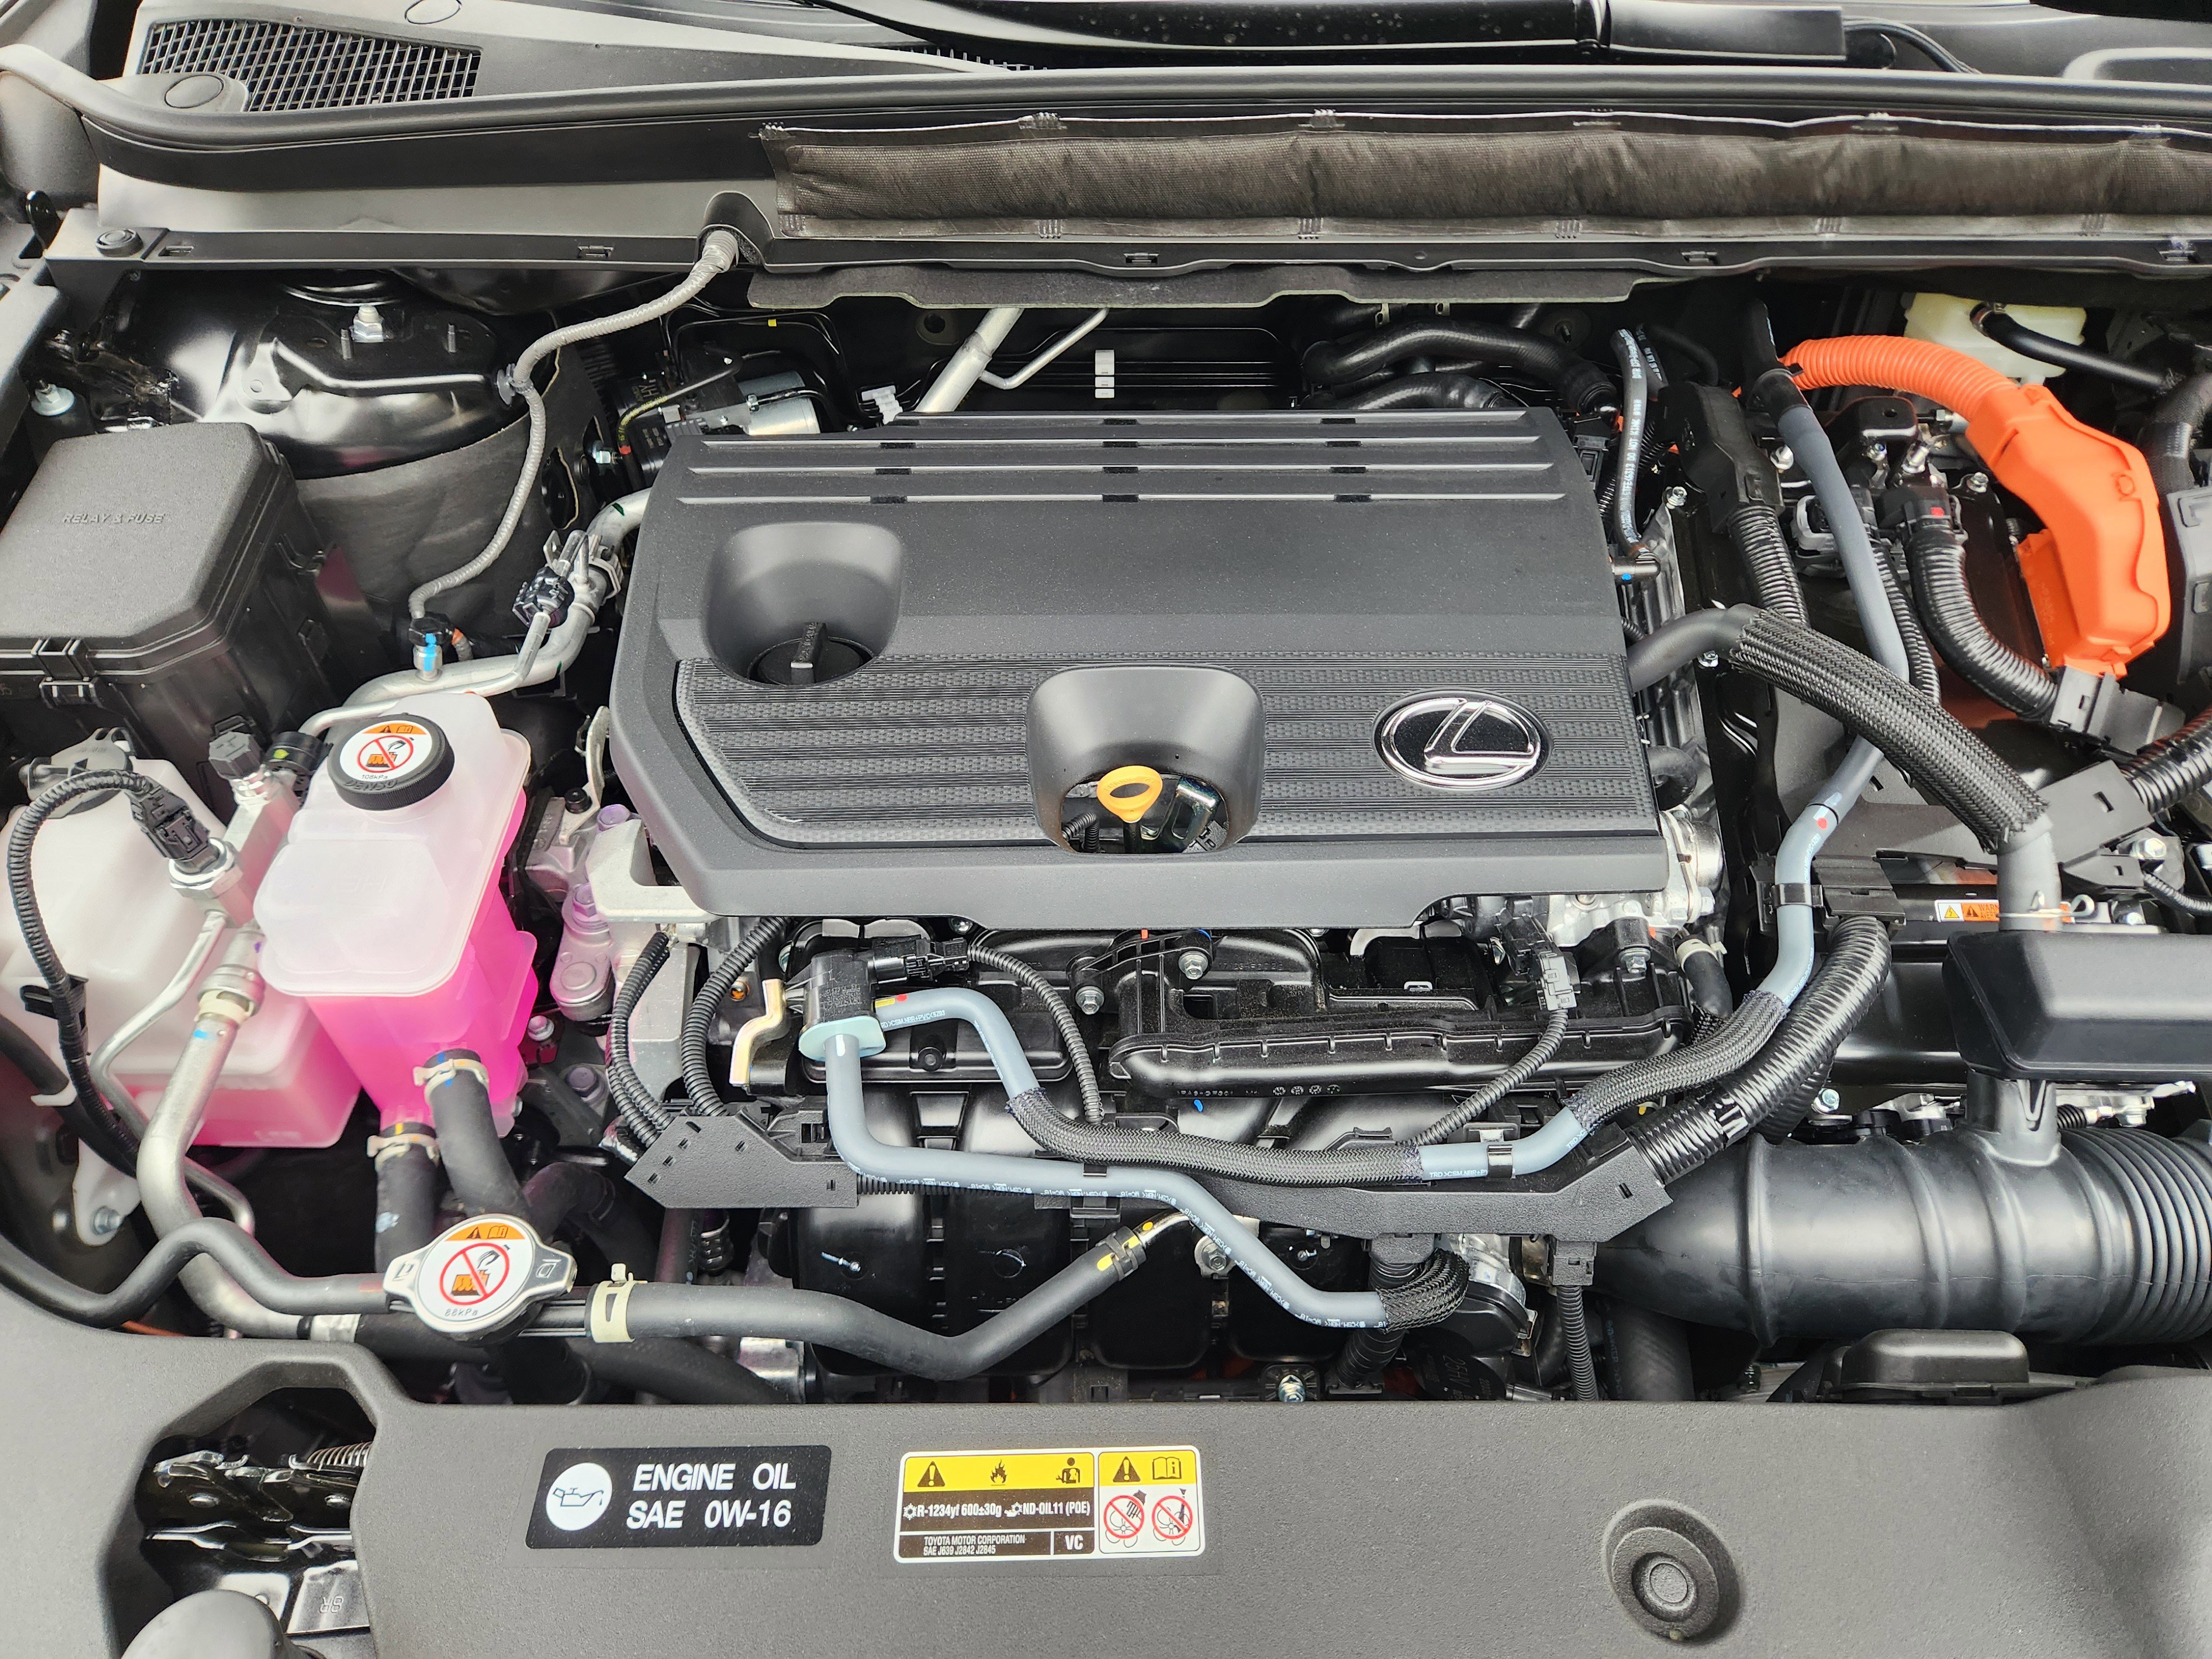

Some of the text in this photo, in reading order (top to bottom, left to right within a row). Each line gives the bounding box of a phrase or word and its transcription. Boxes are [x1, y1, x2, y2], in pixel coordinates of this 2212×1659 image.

[62, 513, 165, 524] RELAY & FUSE
[345, 779, 398, 791] DENSO
[445, 1308, 478, 1317] 88kPa
[633, 1463, 796, 1491] ENGINE OIL
[626, 1499, 792, 1529] SAE 0W-16
[917, 1503, 1002, 1519] R-1234yf 600±30g
[1022, 1501, 1091, 1517] ND-OIL11 (POE)
[924, 1534, 1026, 1546] TOYOTA MOTOR CORPORATION
[1065, 1535, 1084, 1550] VC
[923, 1545, 997, 1556] SAE J639 J2842 J2845
